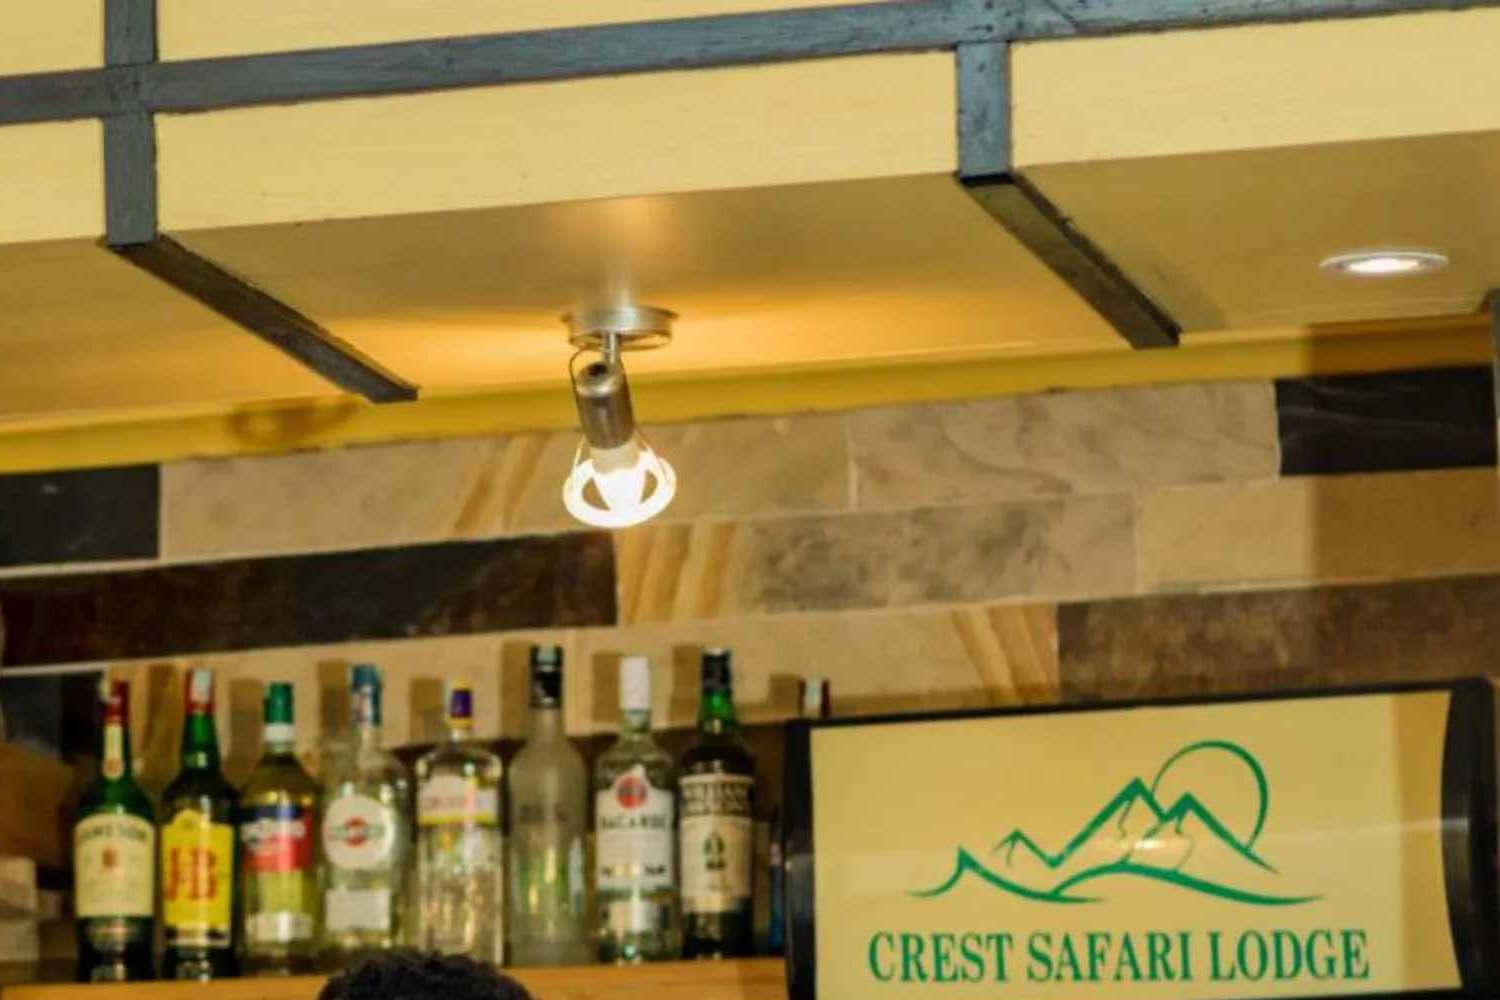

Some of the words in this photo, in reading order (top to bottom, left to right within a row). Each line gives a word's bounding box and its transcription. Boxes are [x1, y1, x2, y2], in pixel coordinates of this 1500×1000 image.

[867, 931, 1013, 982] CREST
[1026, 930, 1192, 982] SAFARI
[1207, 928, 1370, 981] LODGE
